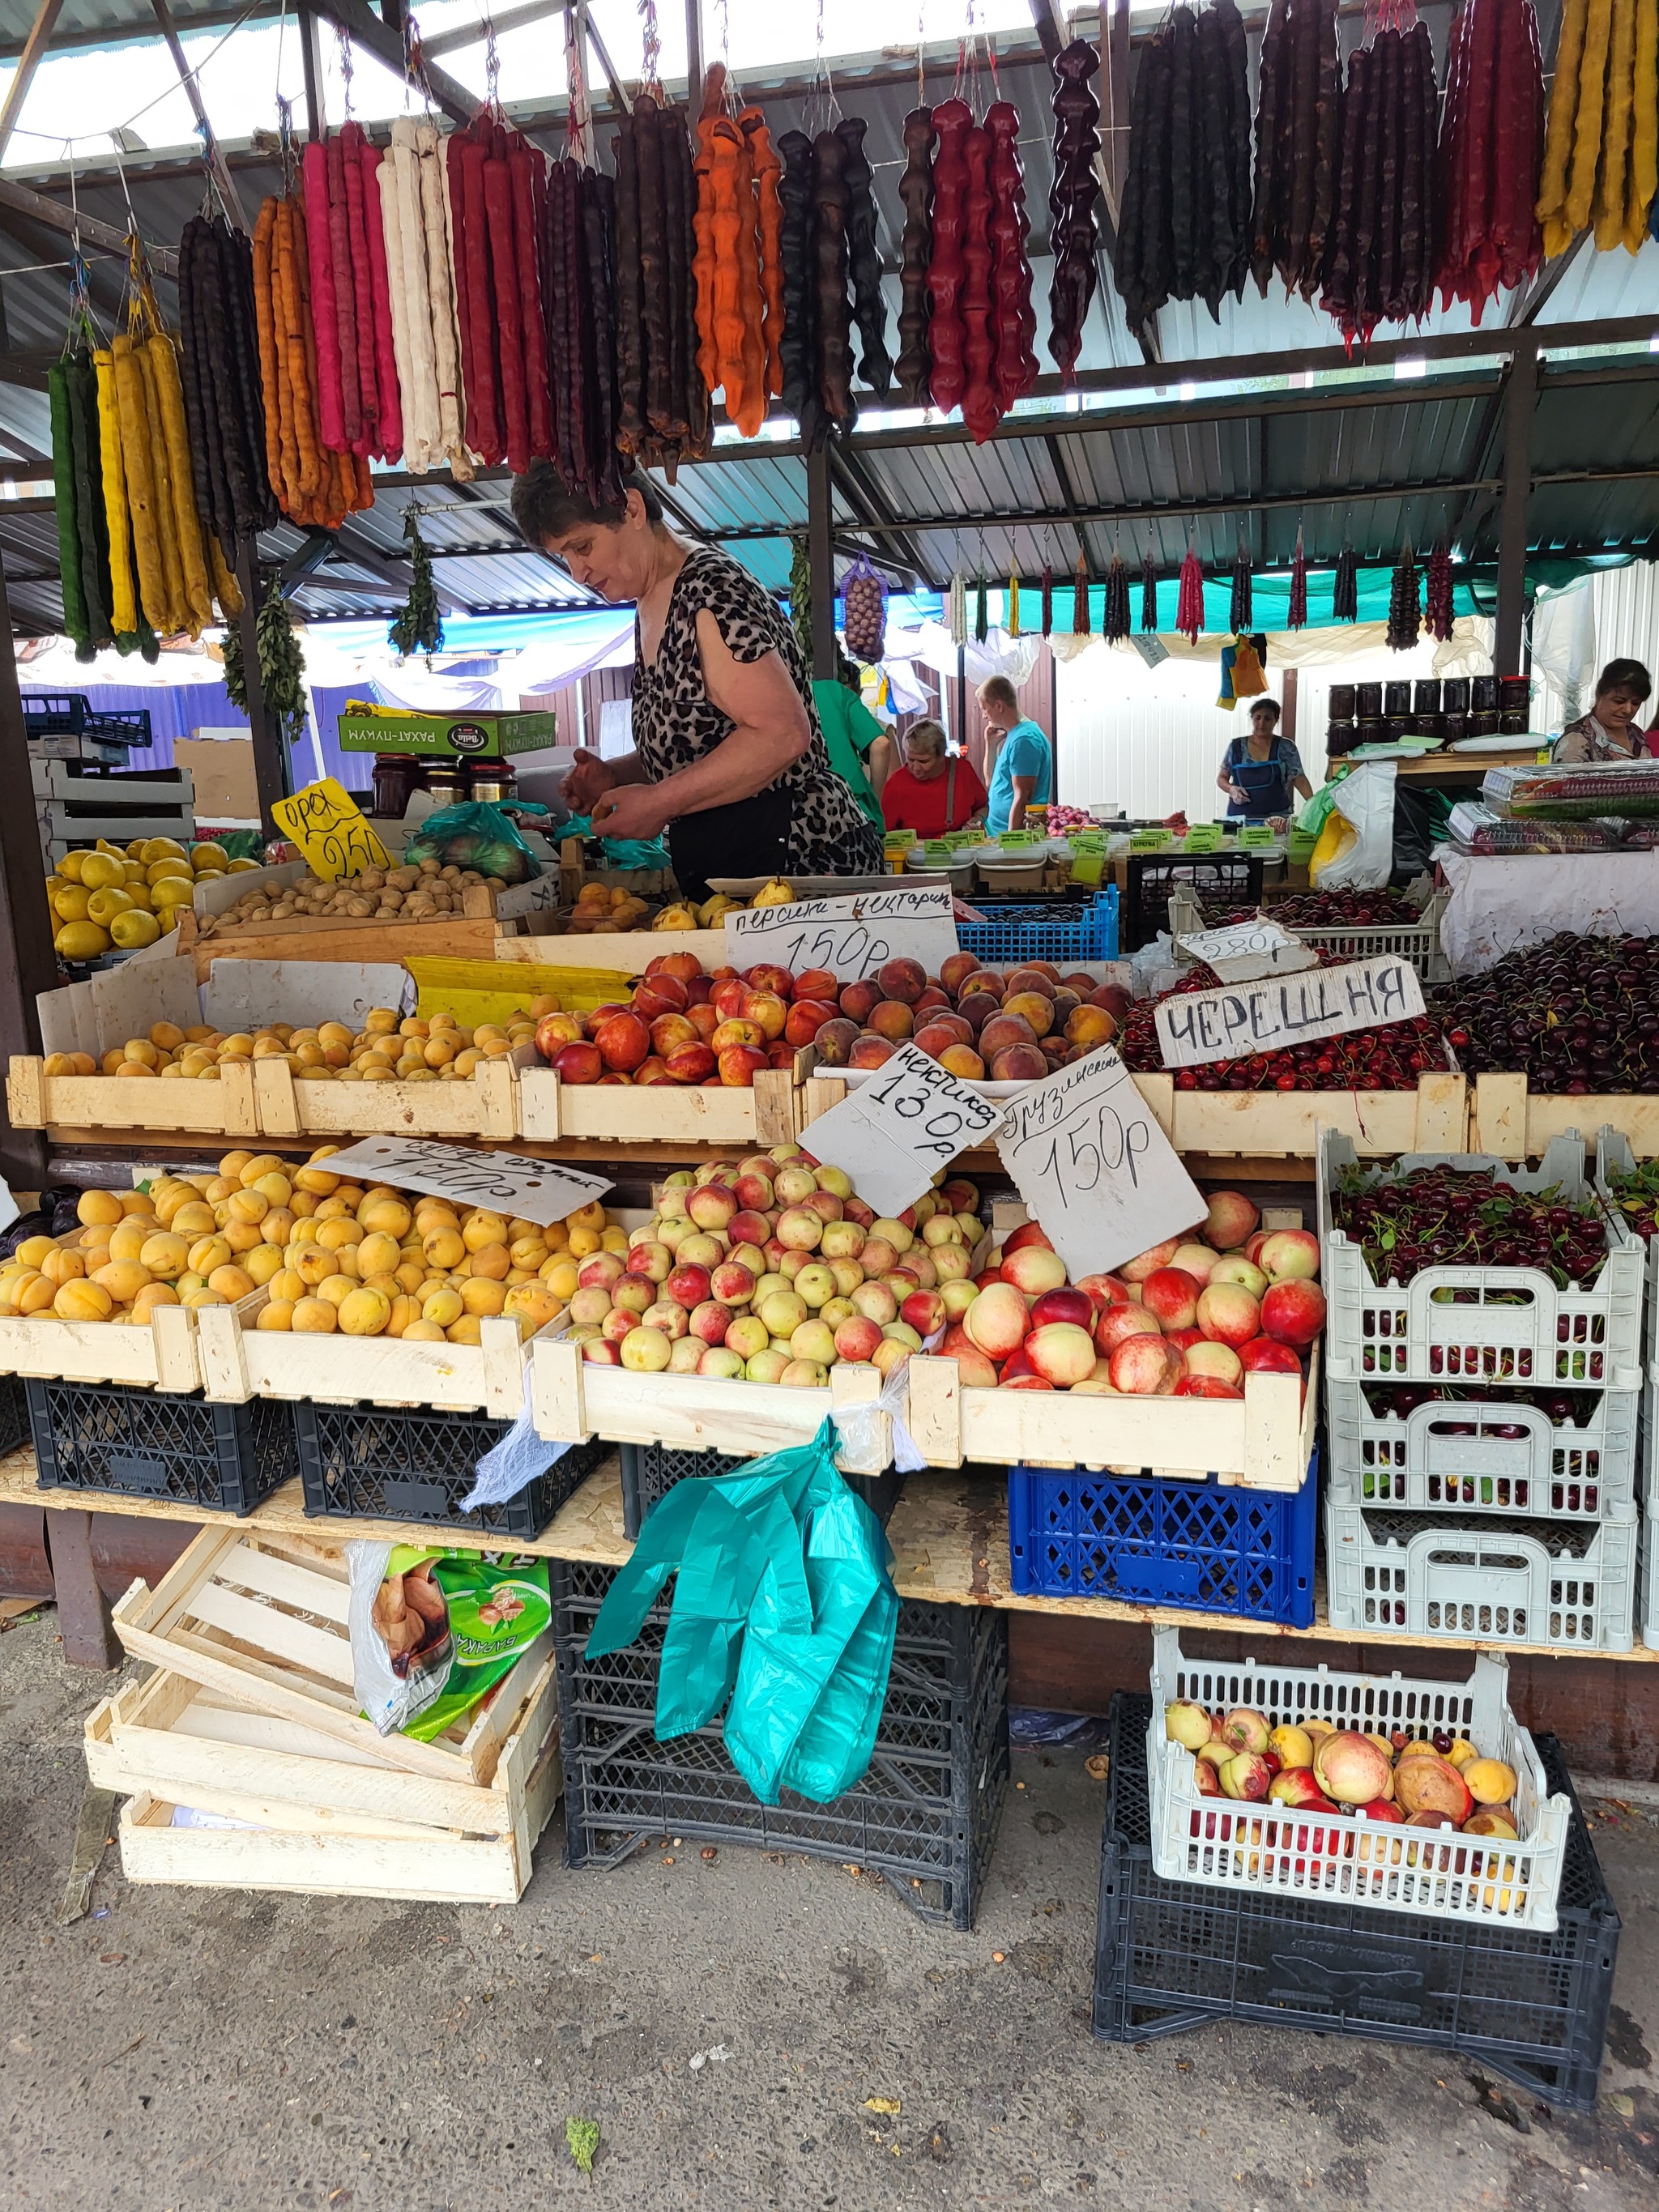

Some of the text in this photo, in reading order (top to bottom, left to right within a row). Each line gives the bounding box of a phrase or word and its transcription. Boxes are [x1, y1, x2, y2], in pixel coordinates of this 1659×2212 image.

[457, 733, 480, 744] Bella
[323, 825, 390, 883] 250
[868, 1073, 962, 1137] 130
[457, 1633, 517, 1655] БАРАКА
